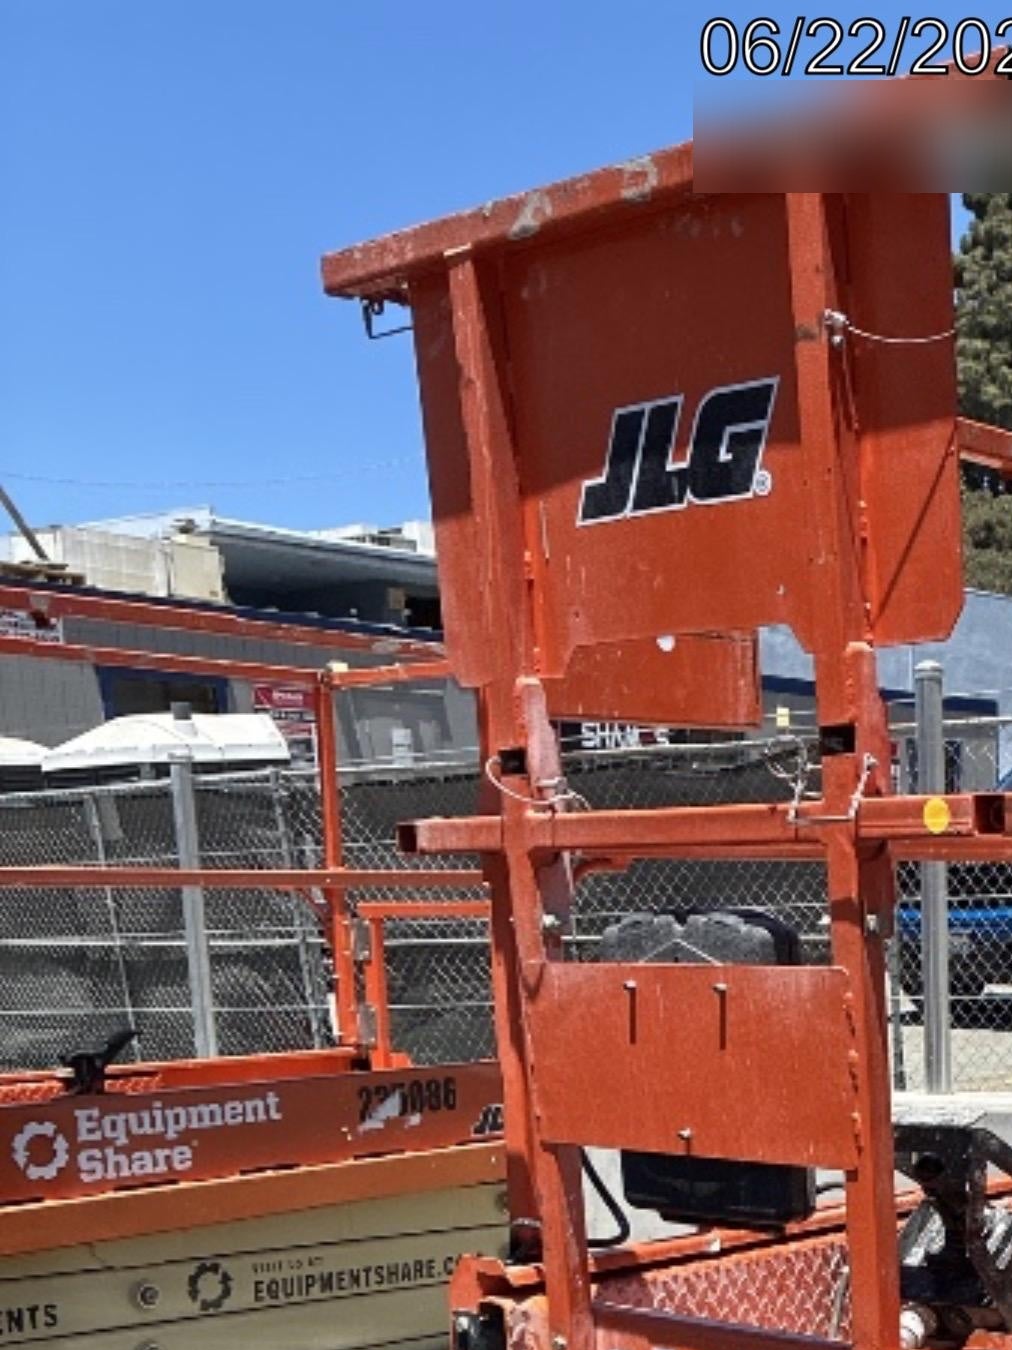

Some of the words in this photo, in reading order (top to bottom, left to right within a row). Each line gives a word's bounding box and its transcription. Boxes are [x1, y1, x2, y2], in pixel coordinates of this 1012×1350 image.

[576, 375, 780, 527] JLG
[74, 1091, 282, 1146] Equipment
[77, 1144, 193, 1183] Share
[253, 1254, 463, 1303] EQUIPMENTSHARE.C
[0, 1303, 58, 1336] NTS
